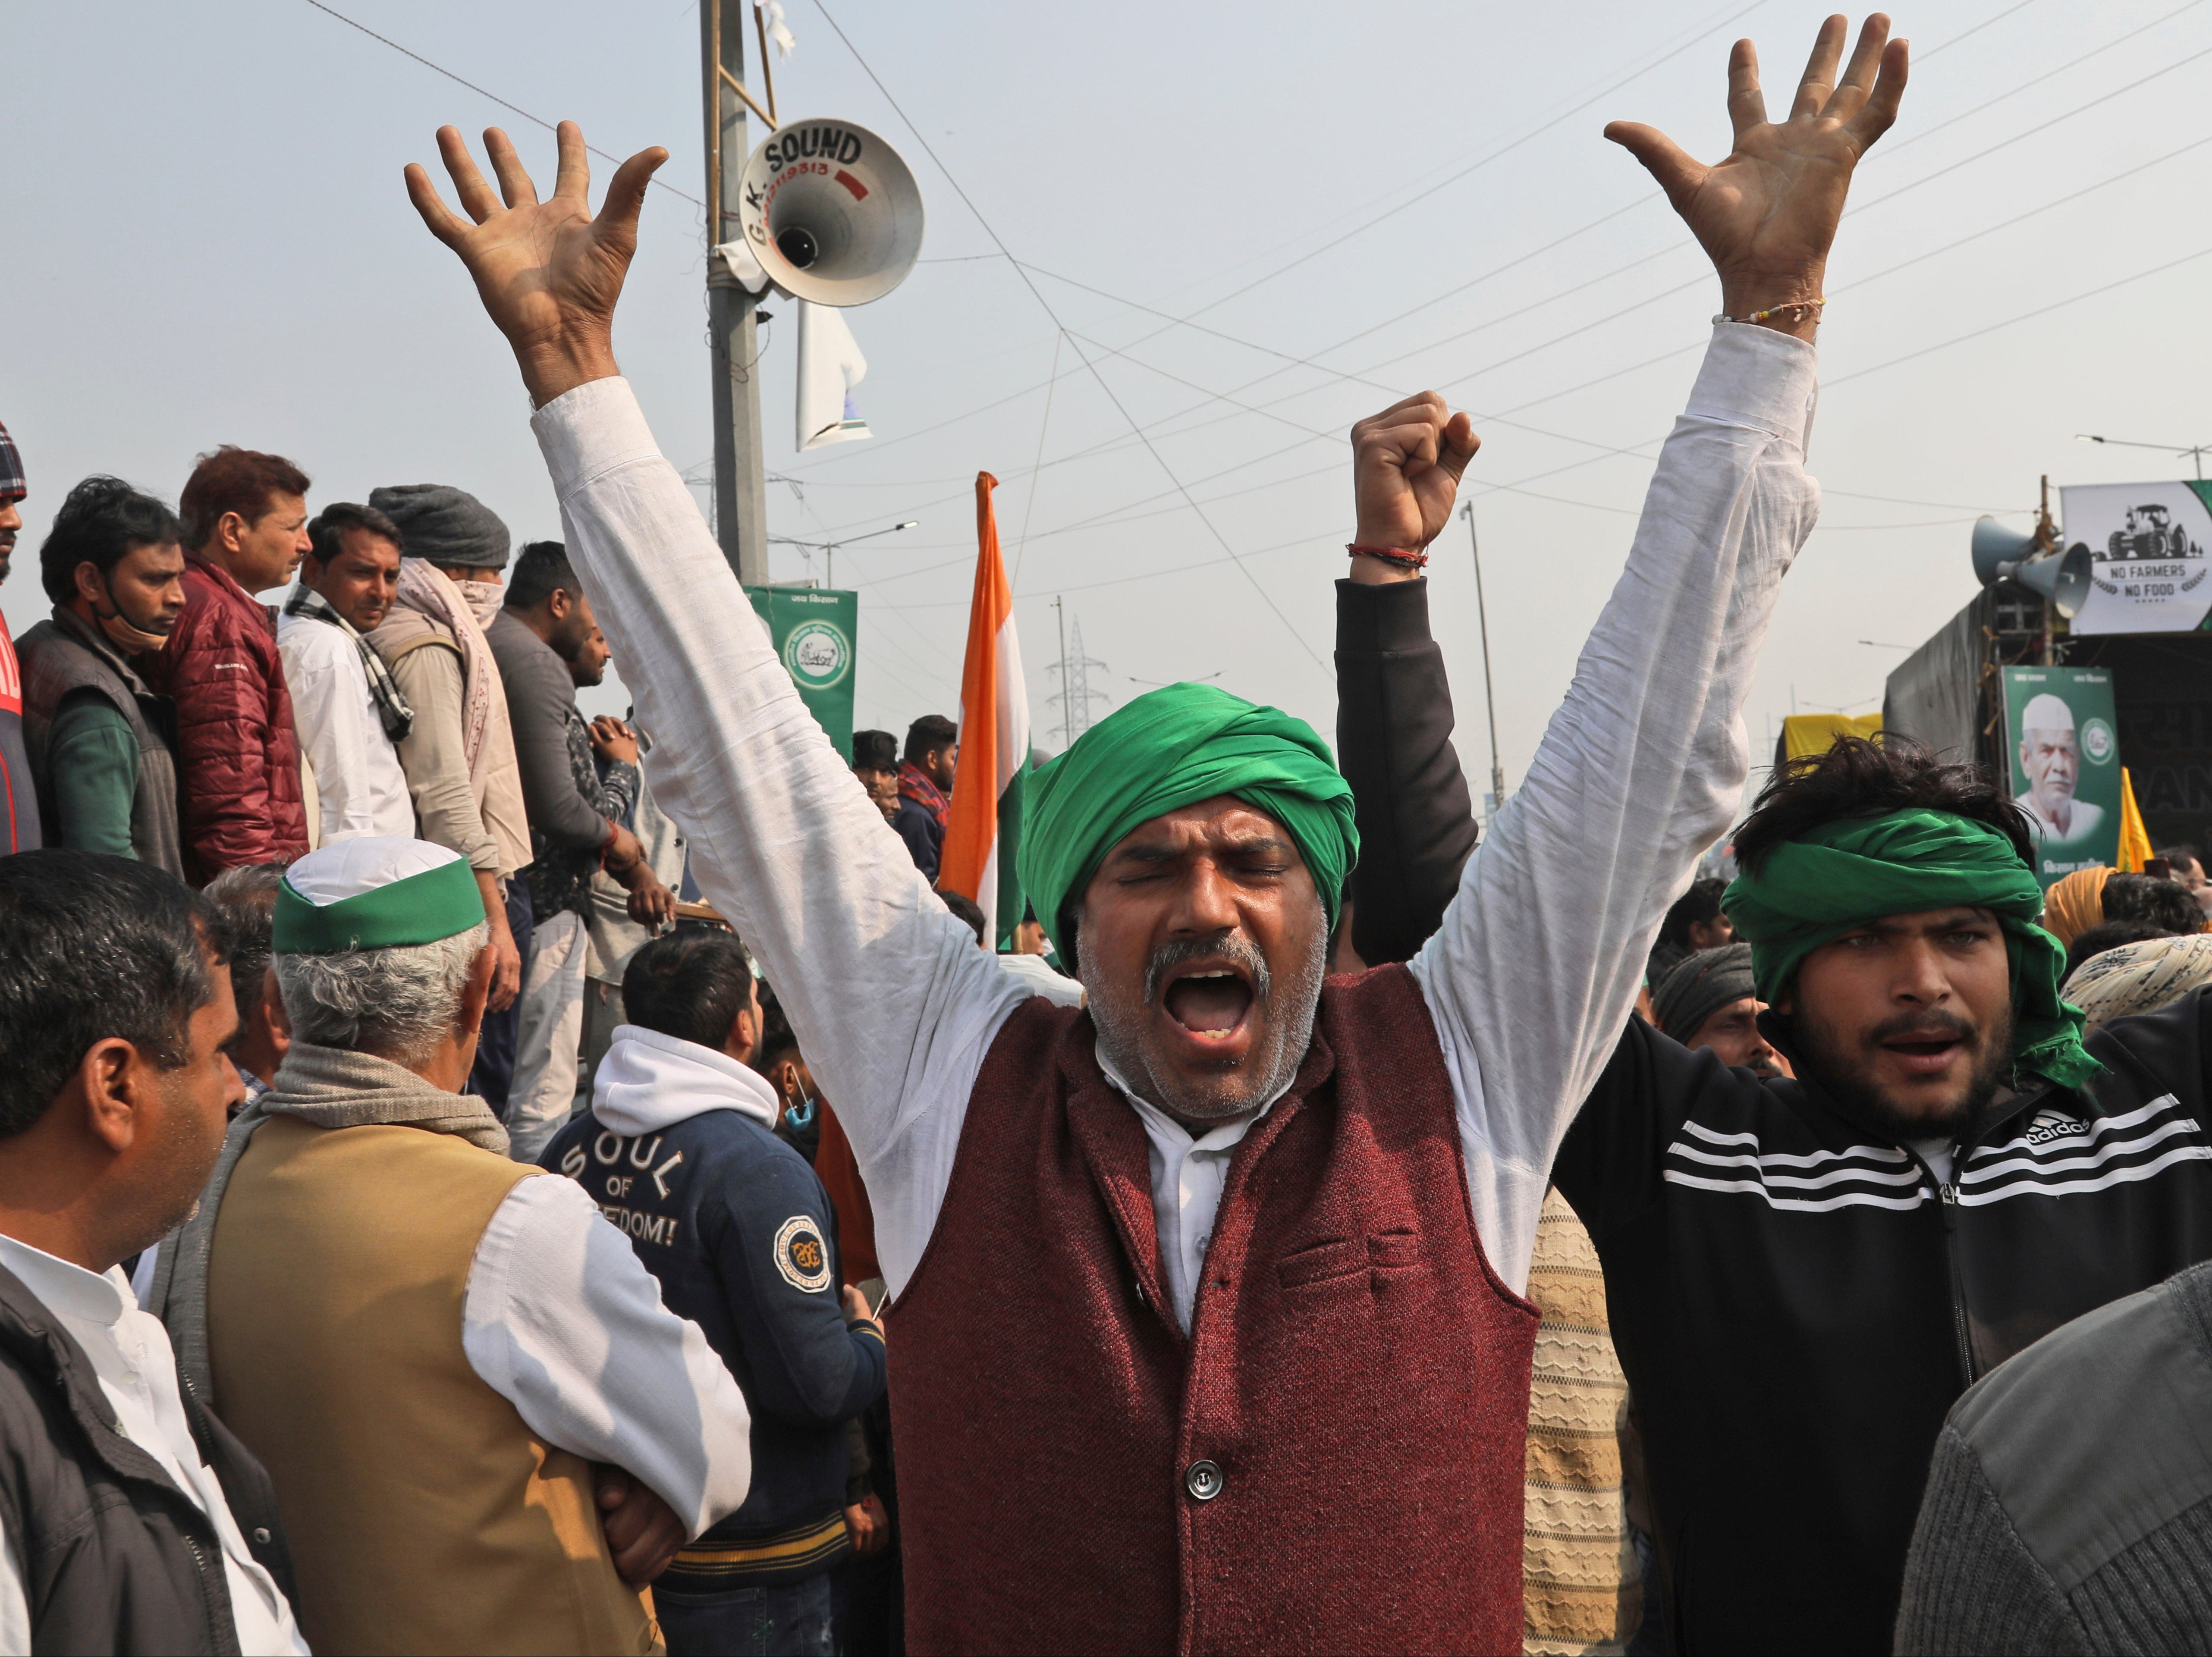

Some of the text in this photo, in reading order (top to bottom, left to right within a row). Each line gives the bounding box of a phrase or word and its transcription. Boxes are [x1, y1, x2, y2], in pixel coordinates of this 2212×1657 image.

[764, 128, 861, 172] SOUND
[2111, 565, 2186, 579] NO FARMERS
[2125, 584, 2174, 596] NO FOOD
[2026, 1119, 2090, 1143] adidas
[561, 1130, 684, 1200] SOUL
[606, 1175, 634, 1199] OF
[598, 1203, 679, 1247] EDOM!
